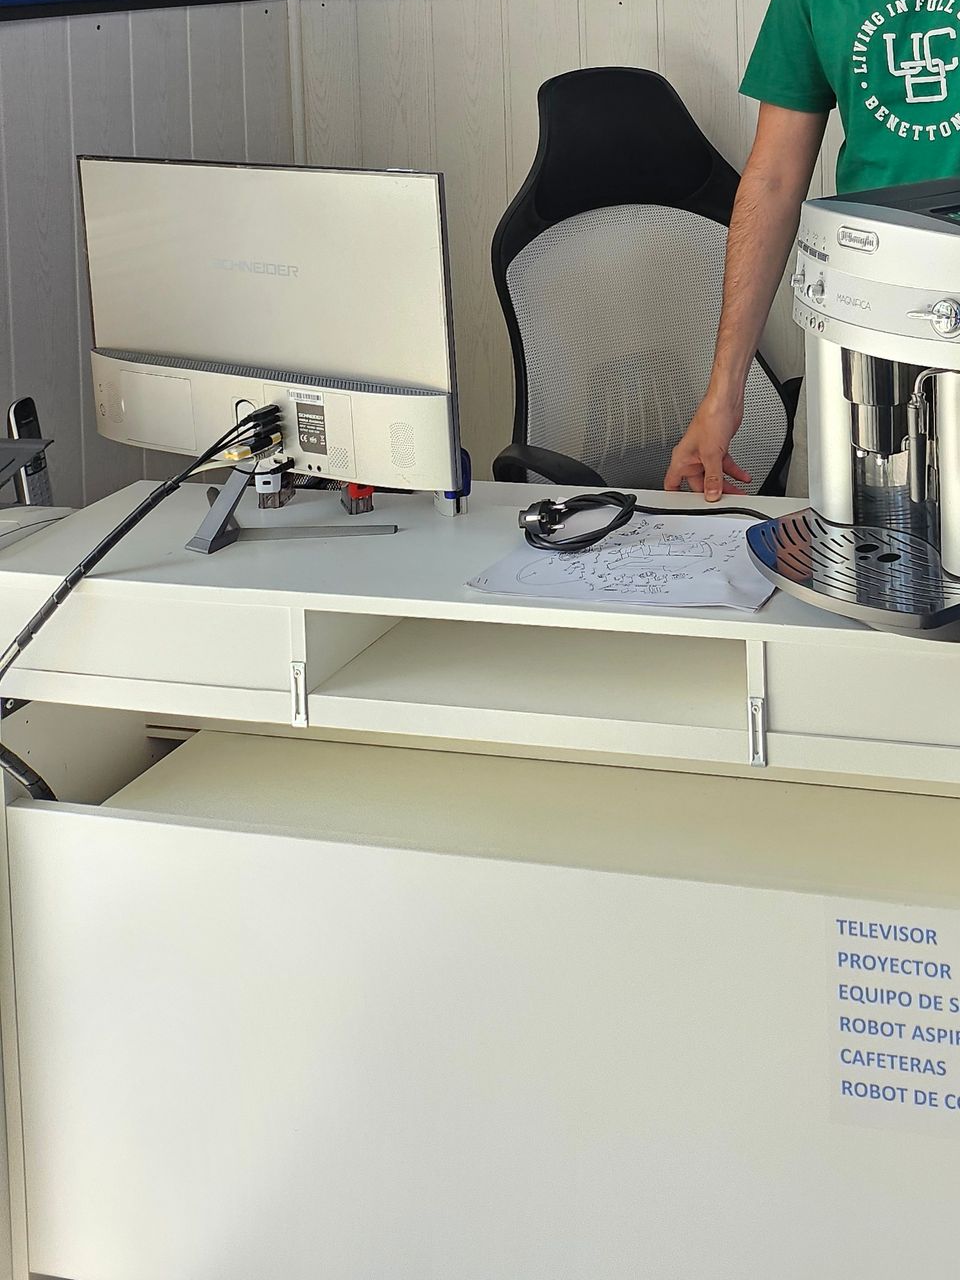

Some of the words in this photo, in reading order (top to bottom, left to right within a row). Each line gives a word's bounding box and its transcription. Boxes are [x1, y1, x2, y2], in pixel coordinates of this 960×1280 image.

[853, 11, 885, 73] LIVING
[836, 293, 871, 311] MAGNIFICA
[836, 918, 938, 945] TELEVISOR
[837, 951, 952, 980] PROYECTOR
[838, 984, 912, 1008] EQUIPO
[919, 993, 943, 1012] DE
[840, 1016, 906, 1039] ROBOT
[840, 1048, 947, 1076] CAFETERAS
[841, 1080, 908, 1103] ROBOT
[914, 1090, 938, 1108] DE
